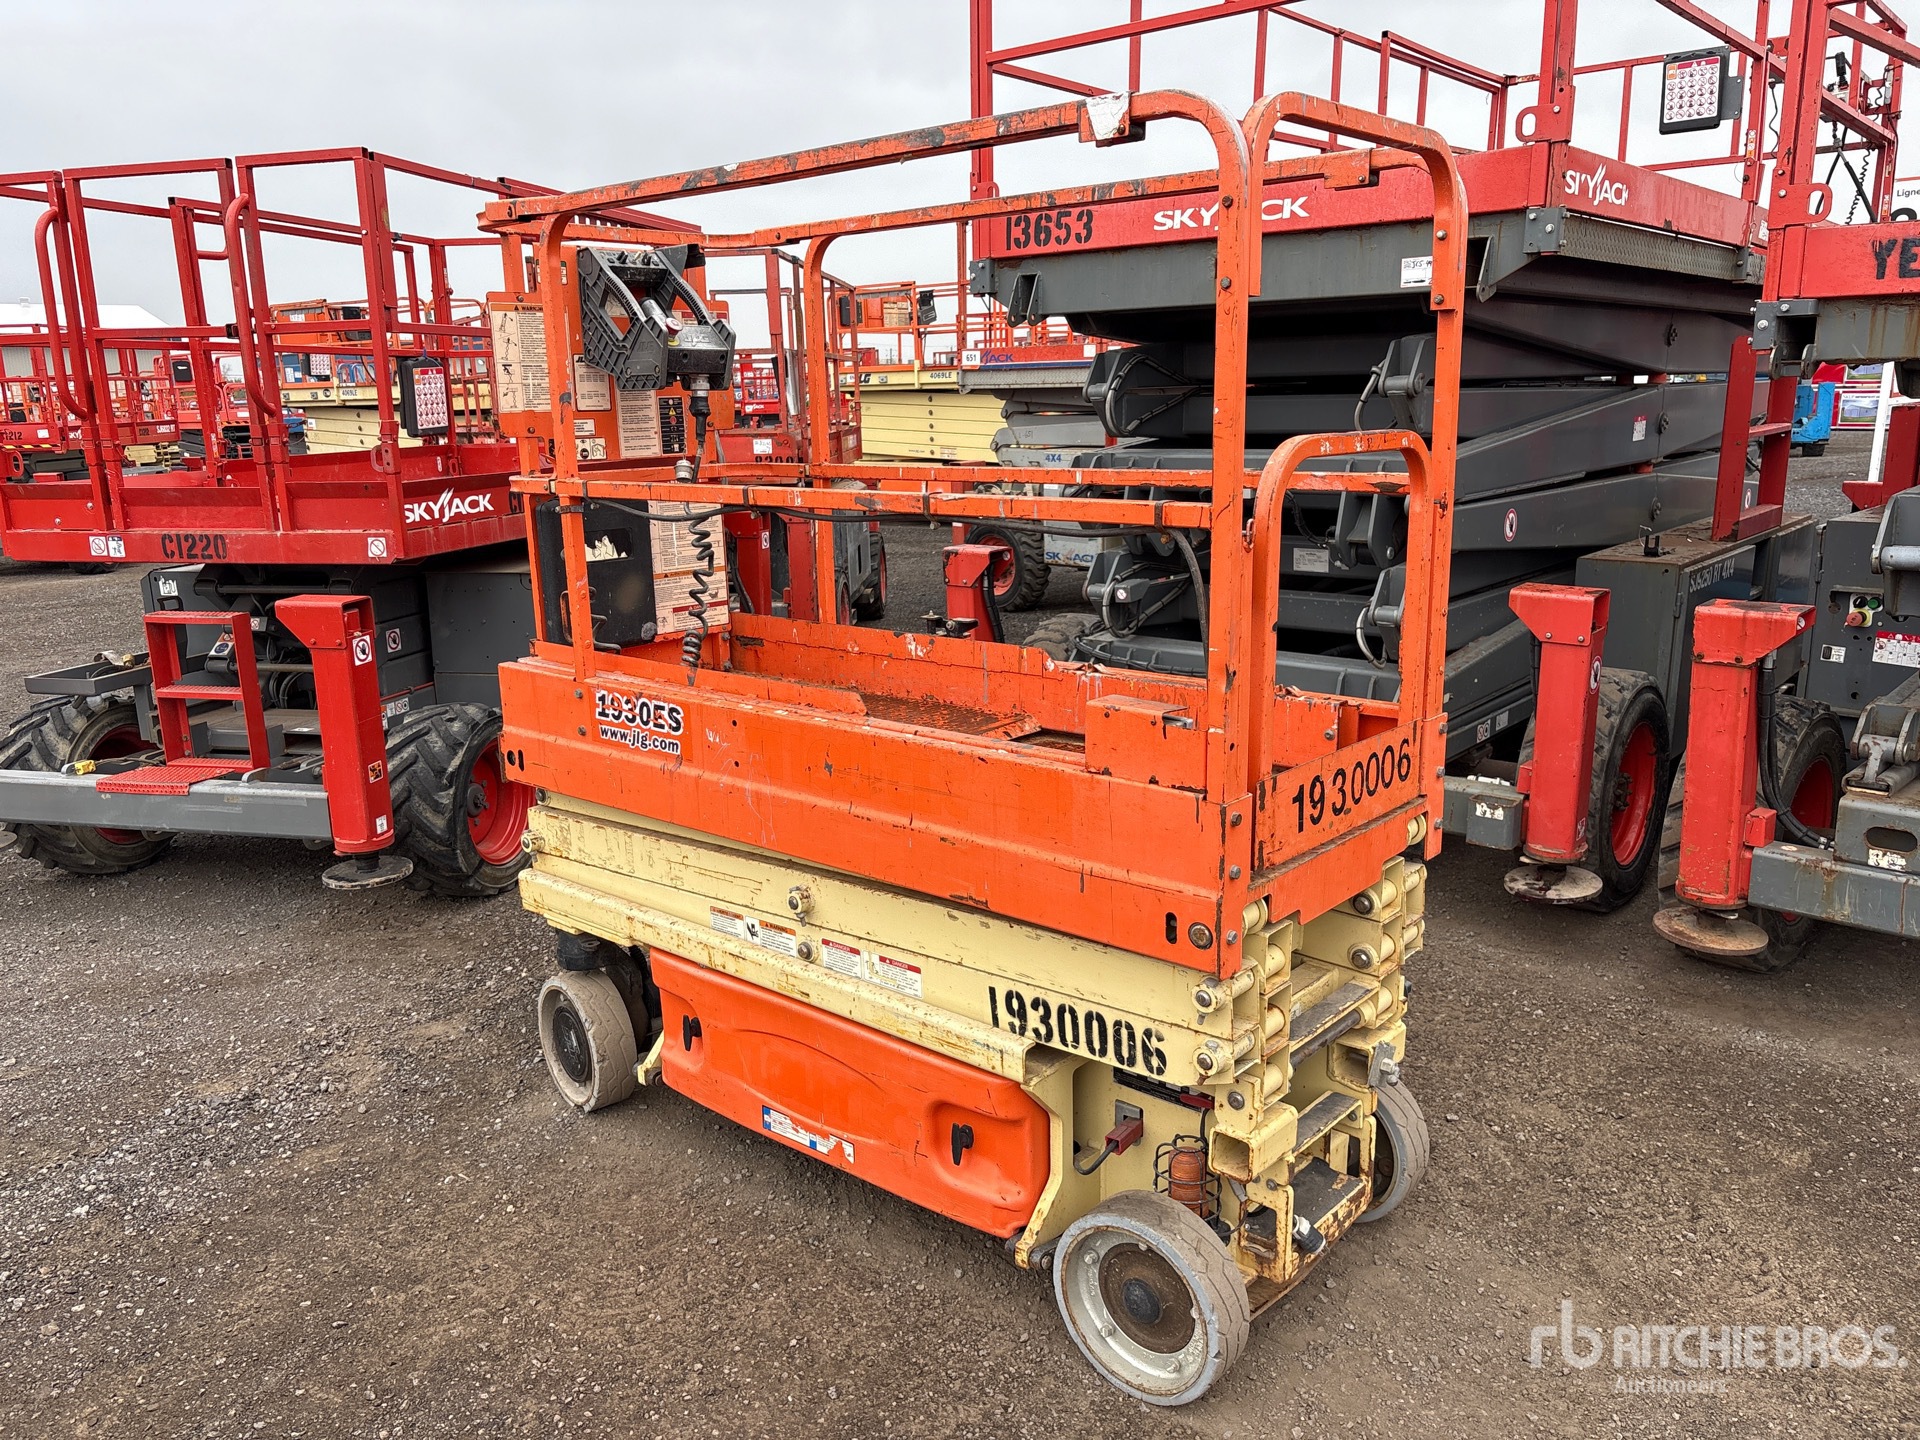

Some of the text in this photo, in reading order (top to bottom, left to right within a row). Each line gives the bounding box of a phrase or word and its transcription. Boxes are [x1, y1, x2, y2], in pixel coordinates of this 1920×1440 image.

[1006, 209, 1093, 250] 13653
[966, 353, 977, 362] 651
[1045, 454, 1062, 462] 4X4
[404, 487, 494, 523] SKYJACK
[161, 533, 228, 560] C1220
[597, 691, 684, 734] 1930ES
[600, 726, 679, 753] www.jlg.com
[1292, 738, 1411, 833] 1930006
[832, 942, 851, 952] DANGER
[891, 960, 909, 969] DANGER
[988, 986, 1167, 1076] 1930006
